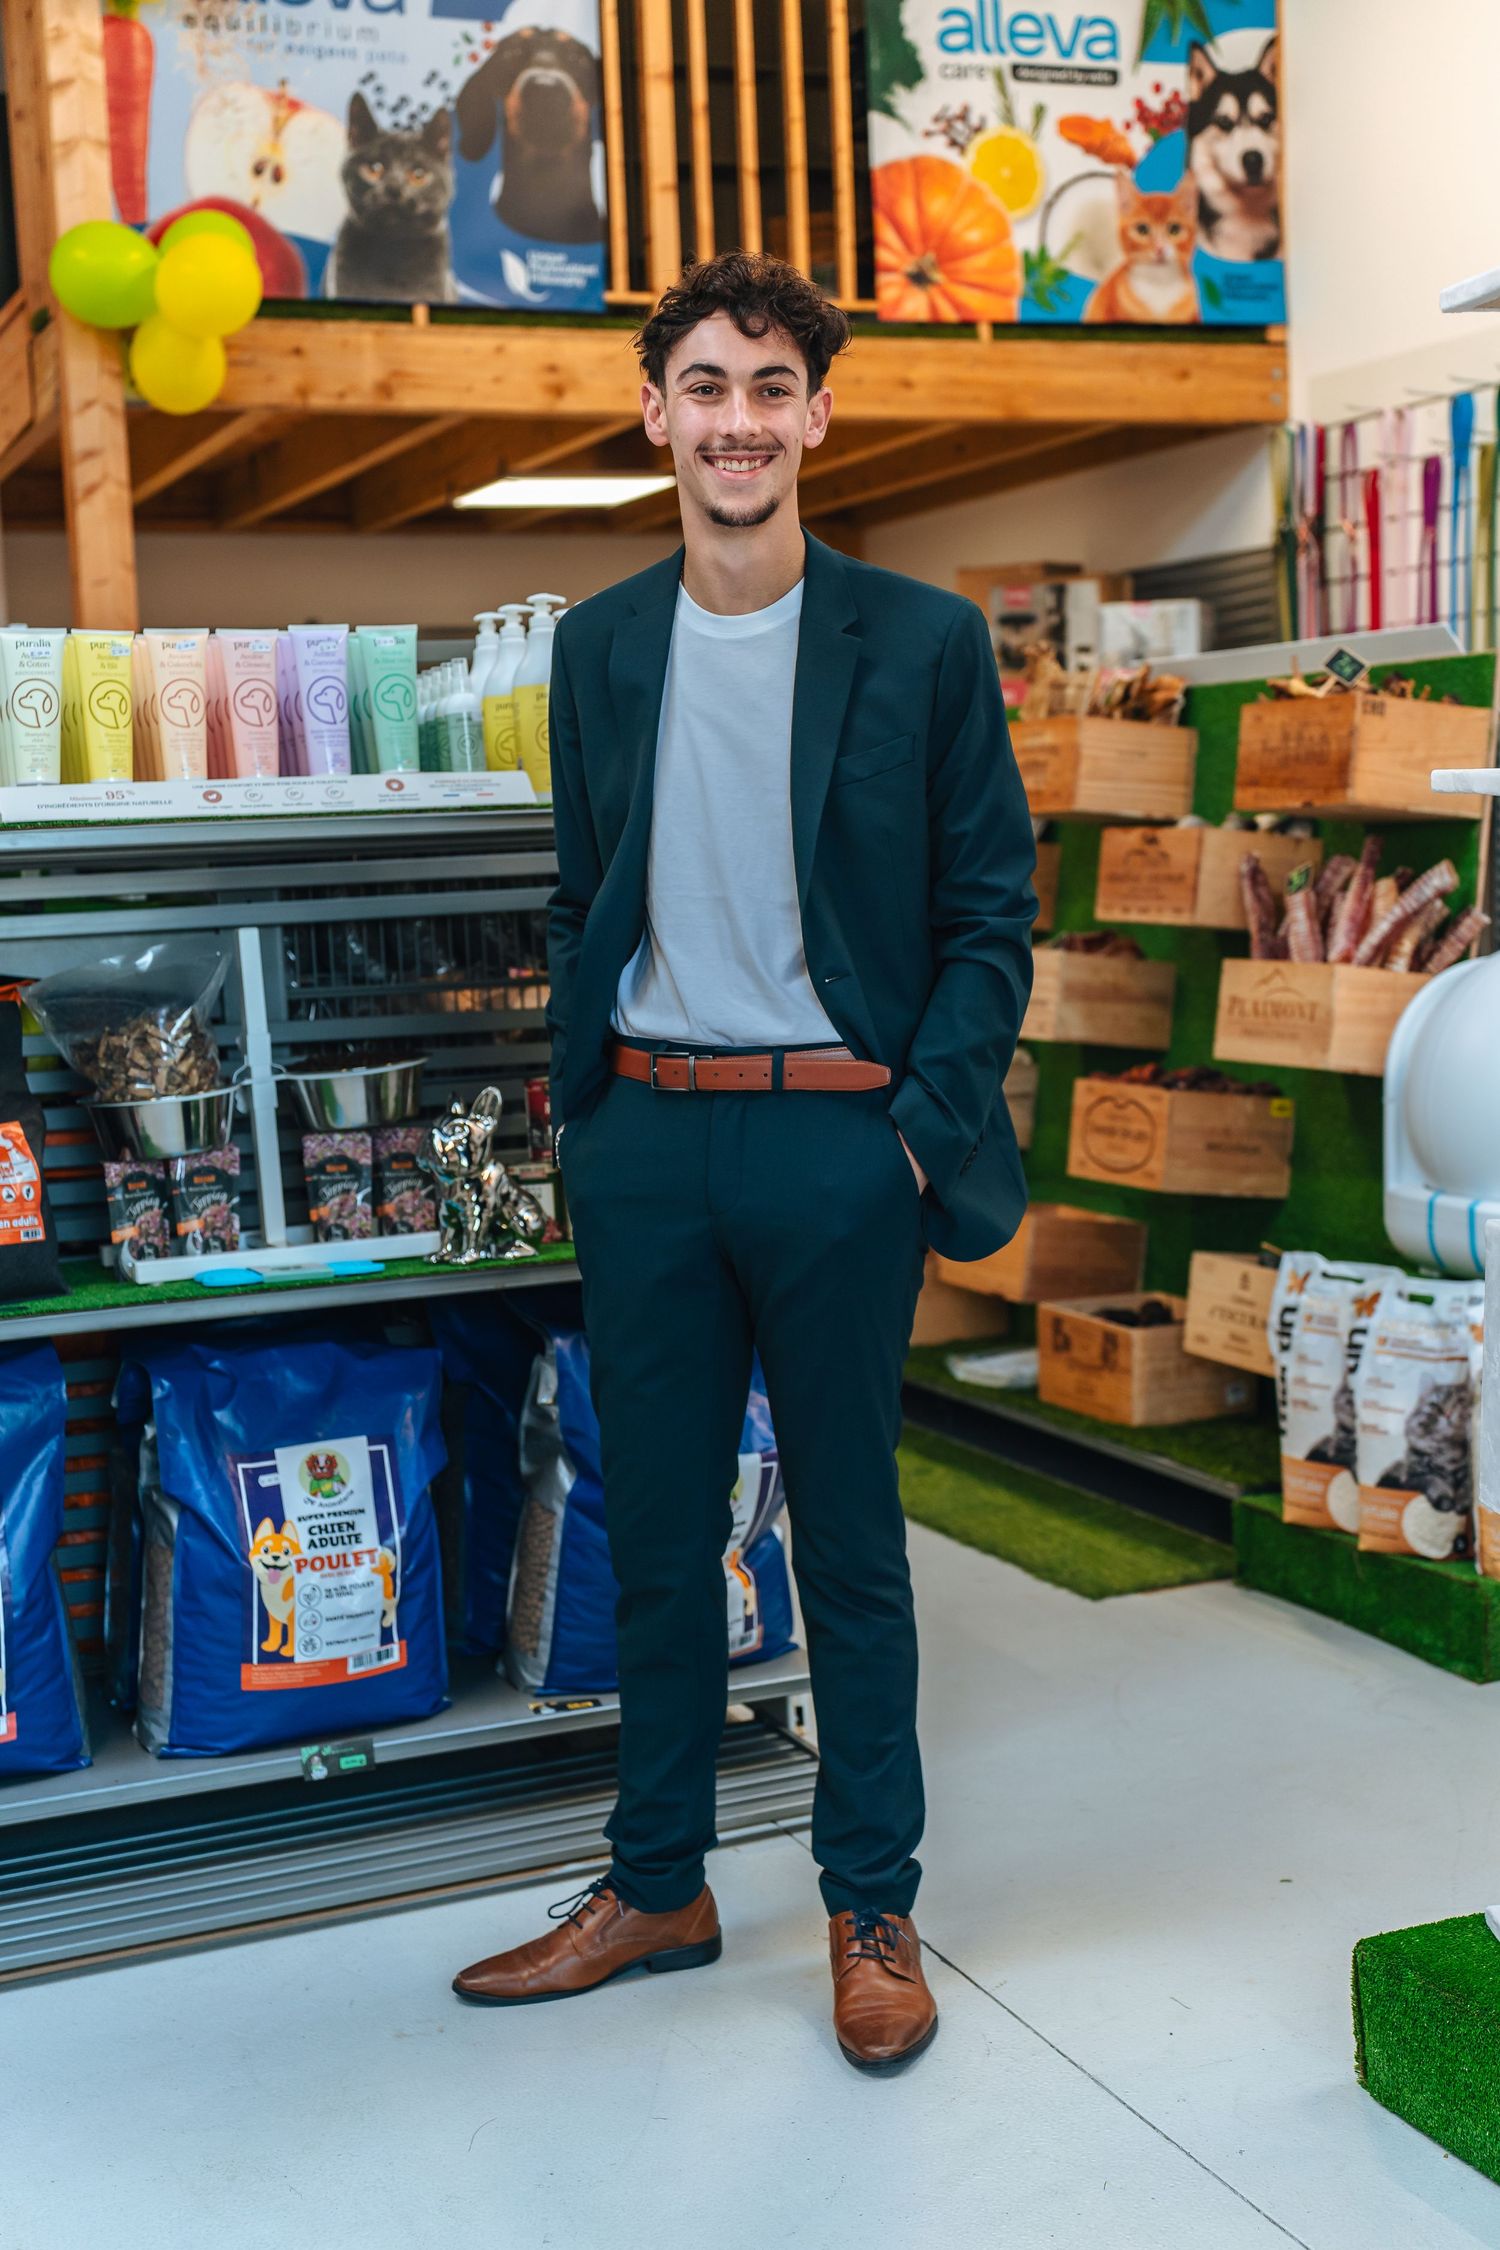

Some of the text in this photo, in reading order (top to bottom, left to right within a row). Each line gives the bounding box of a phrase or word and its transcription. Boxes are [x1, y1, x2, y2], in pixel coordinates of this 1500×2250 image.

[182, 14, 379, 42] equilibrium
[938, 0, 1121, 60] alleva
[939, 63, 986, 80] care
[15, 639, 51, 650] puralia
[297, 1508, 365, 1523] SUPER PREMIUM
[308, 1521, 355, 1536] CHIEN
[308, 1533, 362, 1550] ADULTE
[294, 1548, 378, 1574] POULET
